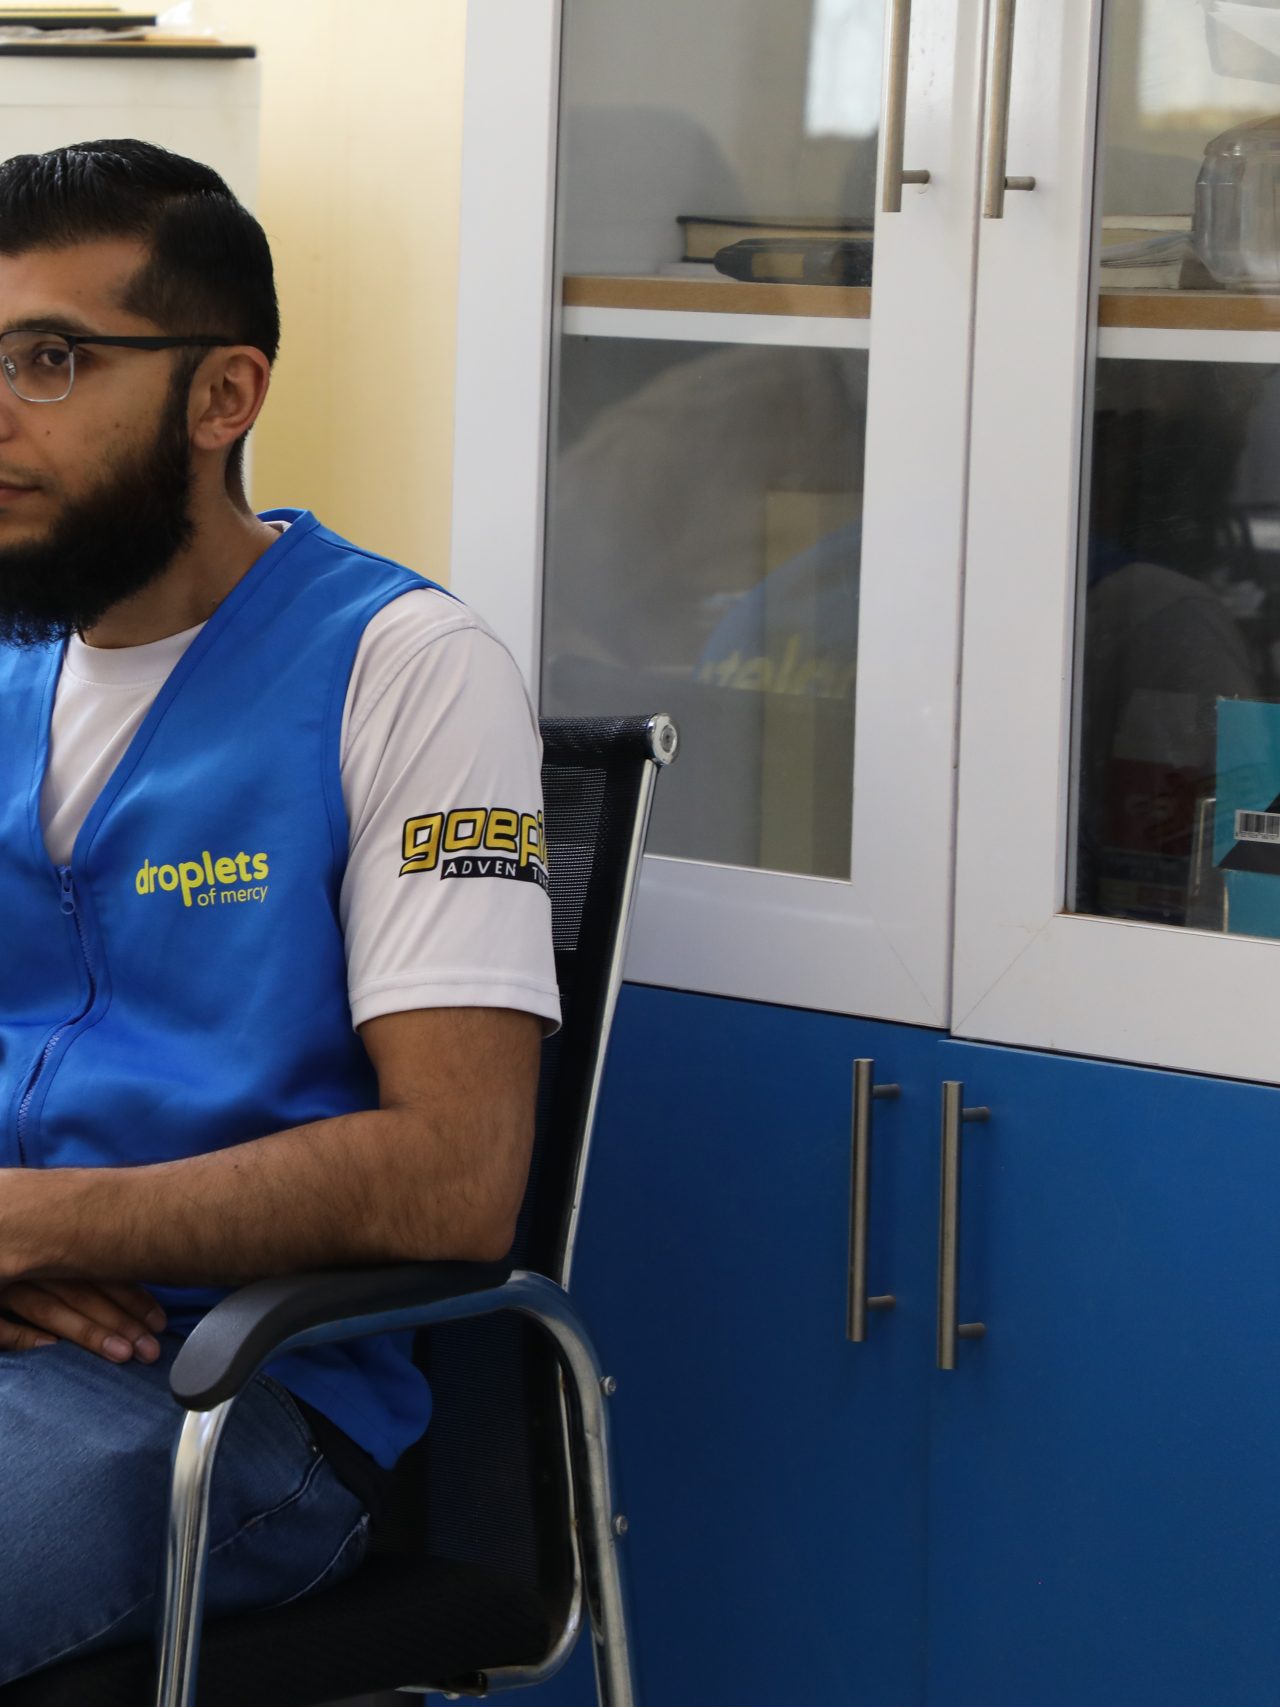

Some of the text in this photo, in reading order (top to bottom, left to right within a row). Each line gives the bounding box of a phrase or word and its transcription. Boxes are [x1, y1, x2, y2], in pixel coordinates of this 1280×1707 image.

[135, 851, 269, 907] droplets
[197, 886, 268, 906] of mercy
